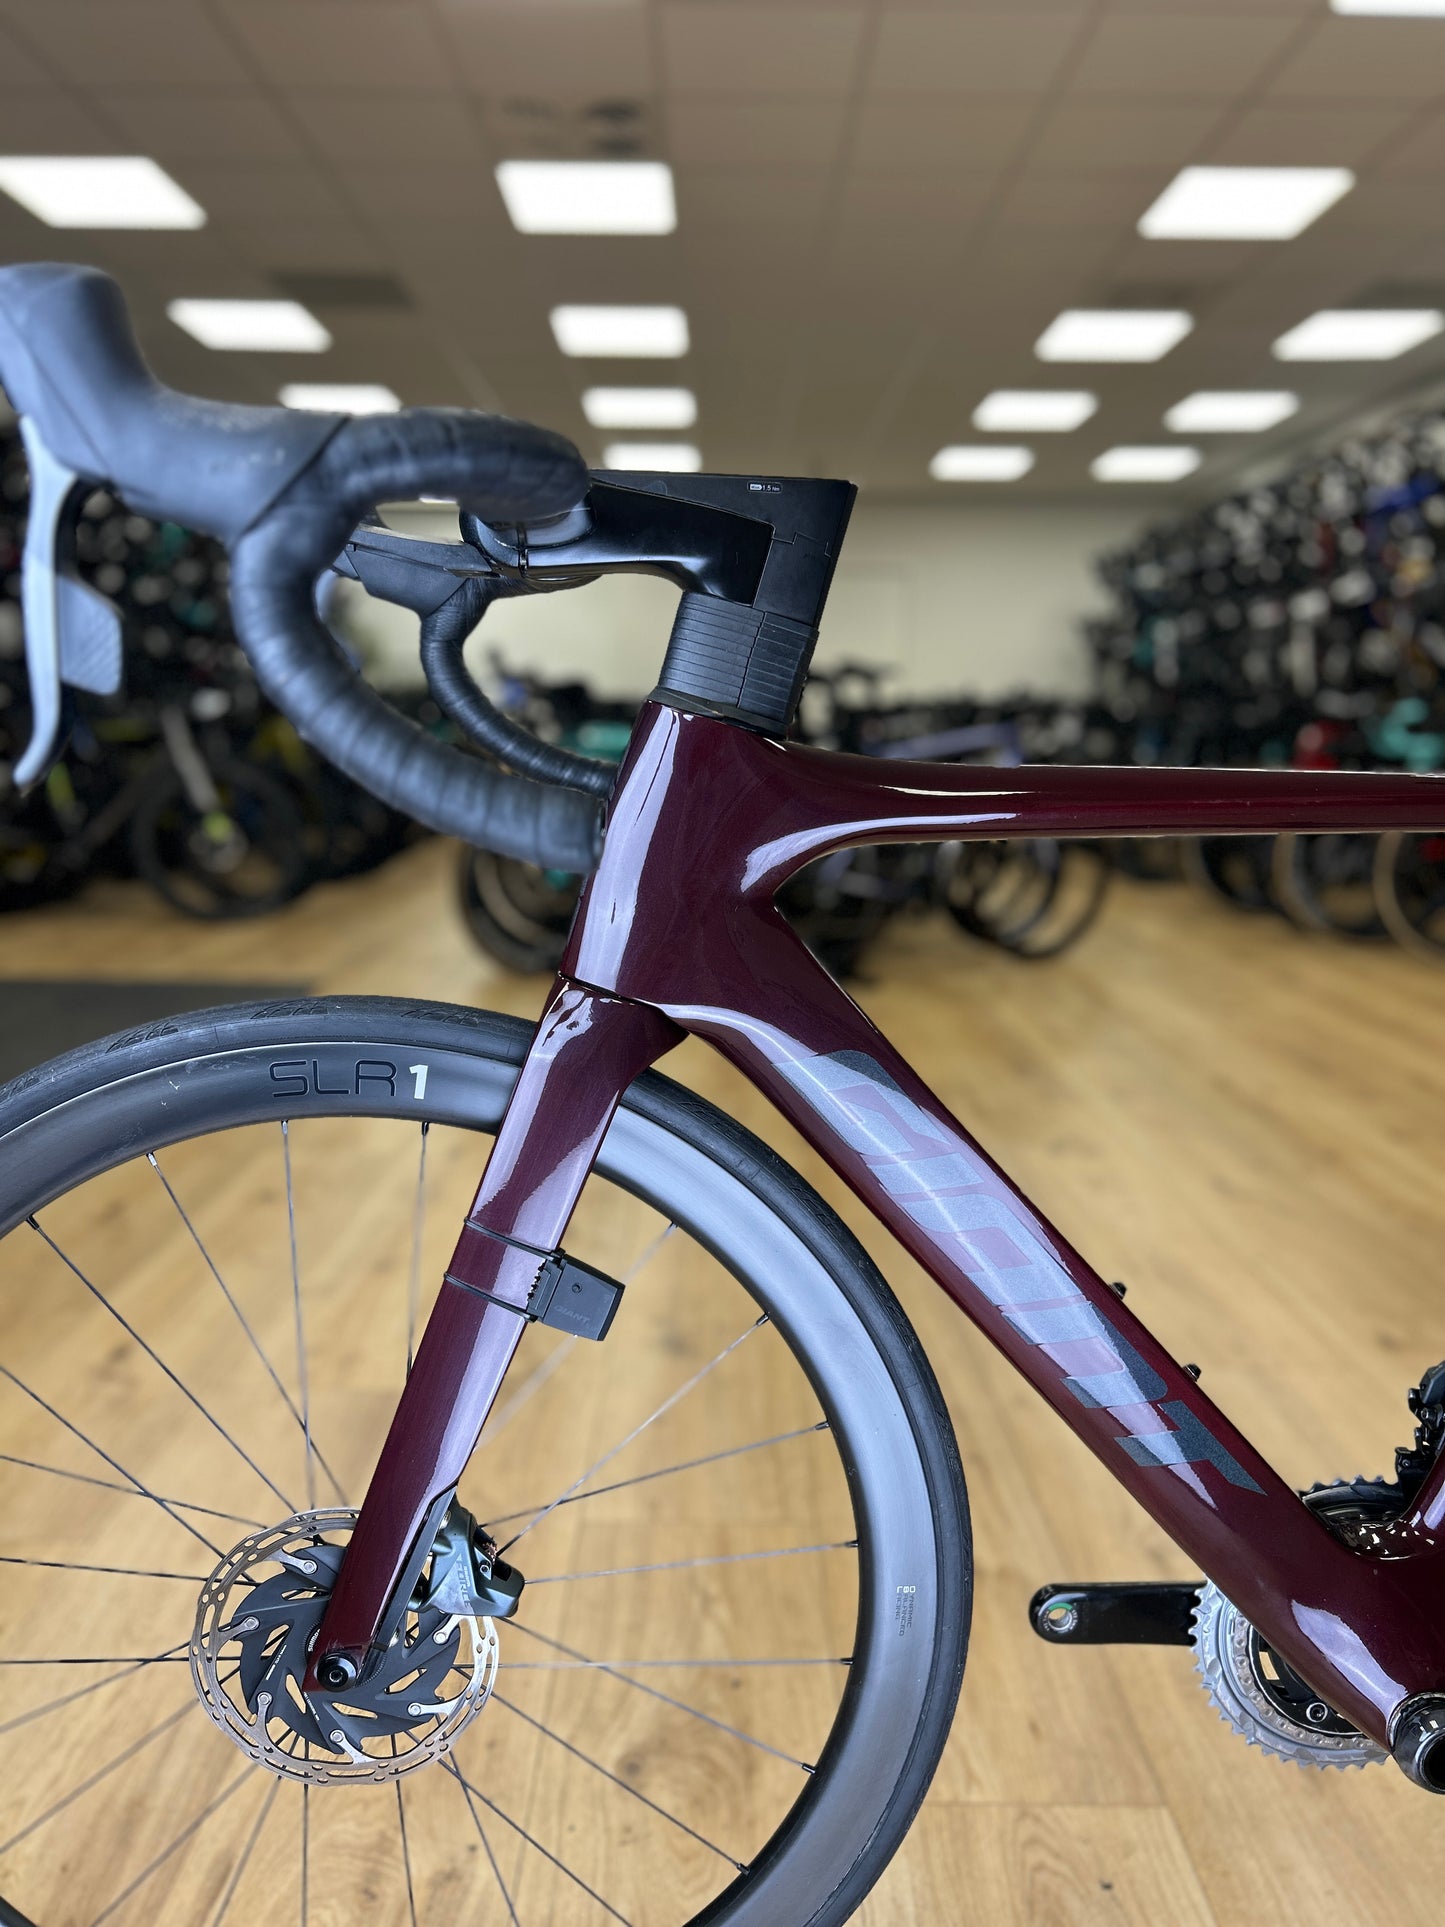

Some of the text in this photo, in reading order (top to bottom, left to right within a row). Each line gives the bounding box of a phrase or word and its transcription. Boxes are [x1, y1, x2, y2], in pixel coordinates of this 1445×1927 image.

[269, 1059, 429, 1100] SLR 1
[771, 1050, 1268, 1496] GIANT
[554, 1305, 592, 1326] GIANT
[456, 1560, 471, 1608] FORCE
